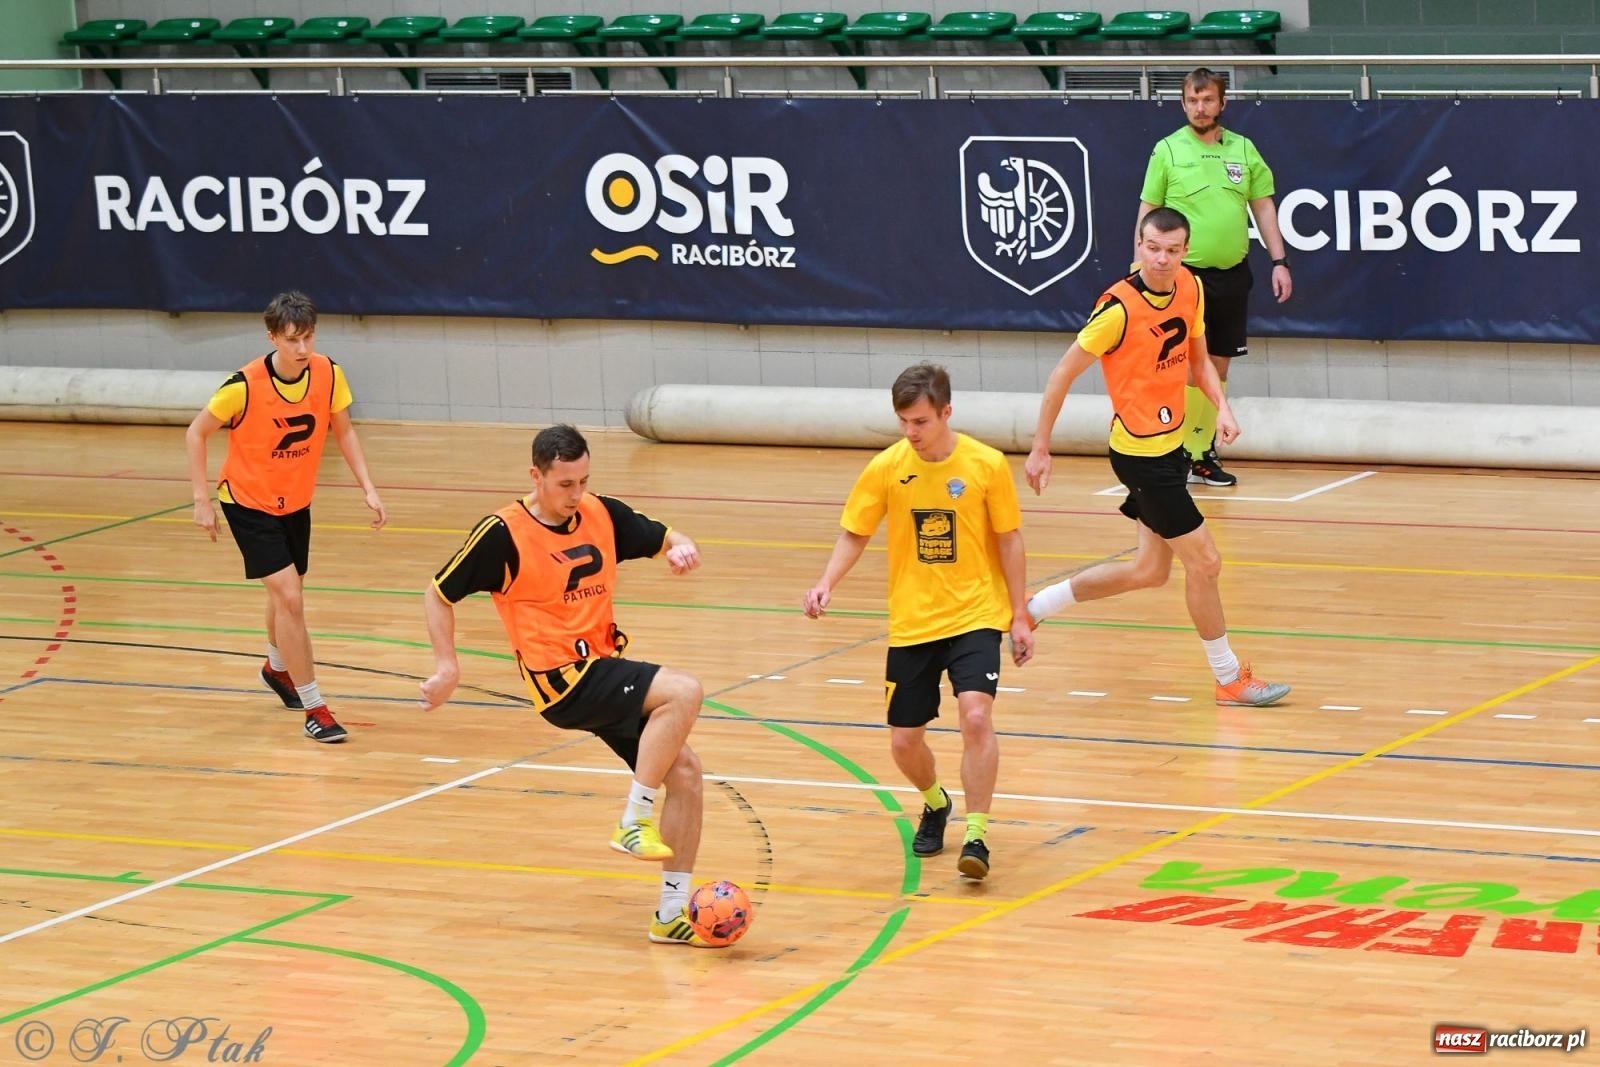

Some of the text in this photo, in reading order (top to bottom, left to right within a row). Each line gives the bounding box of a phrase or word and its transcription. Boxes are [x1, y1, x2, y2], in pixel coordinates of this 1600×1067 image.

[94, 156, 429, 236] RACIBÓRZ
[1247, 166, 1581, 254] CIBÓRZ
[671, 239, 796, 269] RACIBÓRZ
[1155, 351, 1189, 373] PATRICK
[1159, 406, 1172, 425] 8
[271, 445, 311, 459] PATRICK
[277, 496, 286, 510] 3
[563, 584, 608, 604] PATRICK
[577, 639, 588, 658] 1
[1073, 894, 1600, 958] AFAKO
